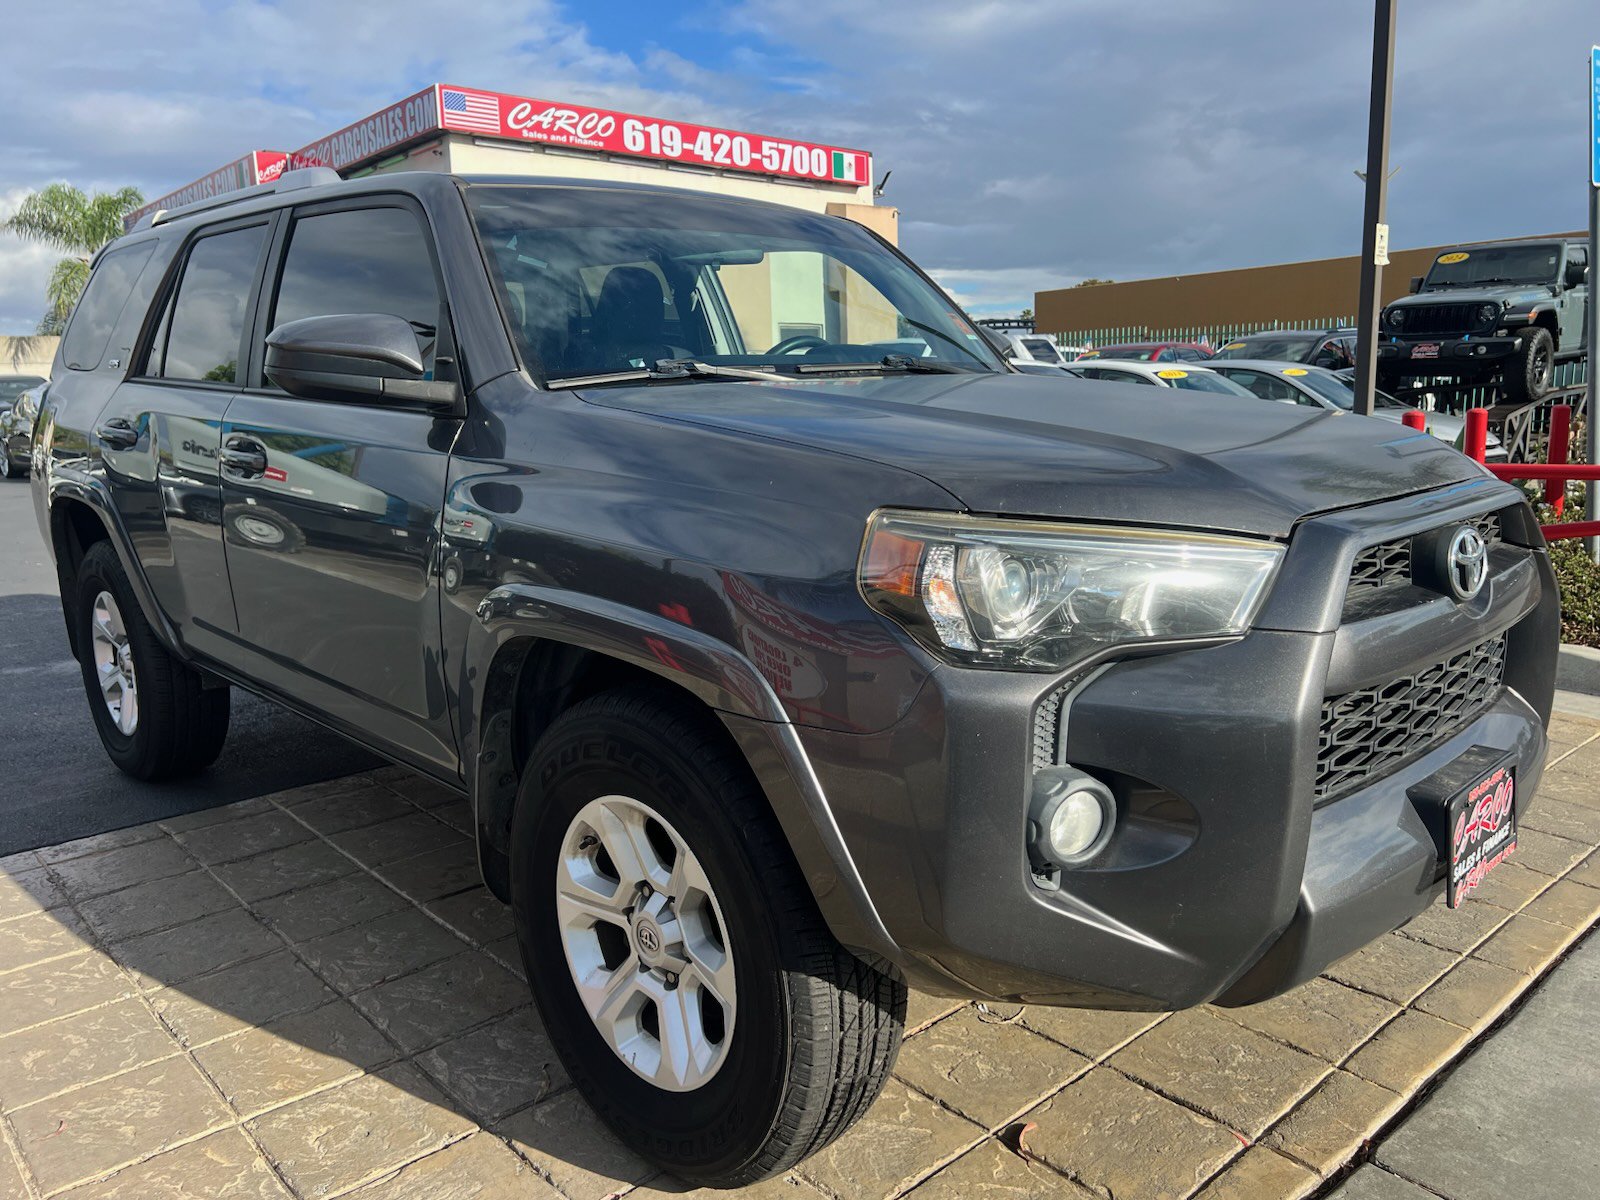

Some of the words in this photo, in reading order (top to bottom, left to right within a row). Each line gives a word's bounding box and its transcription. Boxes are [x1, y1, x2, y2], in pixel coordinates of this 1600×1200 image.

[331, 91, 437, 168] CARCOSALES.COM
[506, 102, 616, 138] CARCO
[622, 118, 828, 178] 619-420-5700
[522, 128, 548, 140] Sales
[550, 133, 567, 143] and
[569, 135, 604, 148] Finance
[1453, 777, 1514, 866] CARCO
[1454, 851, 1476, 883] SALES
[1481, 821, 1511, 856] FINANCE
